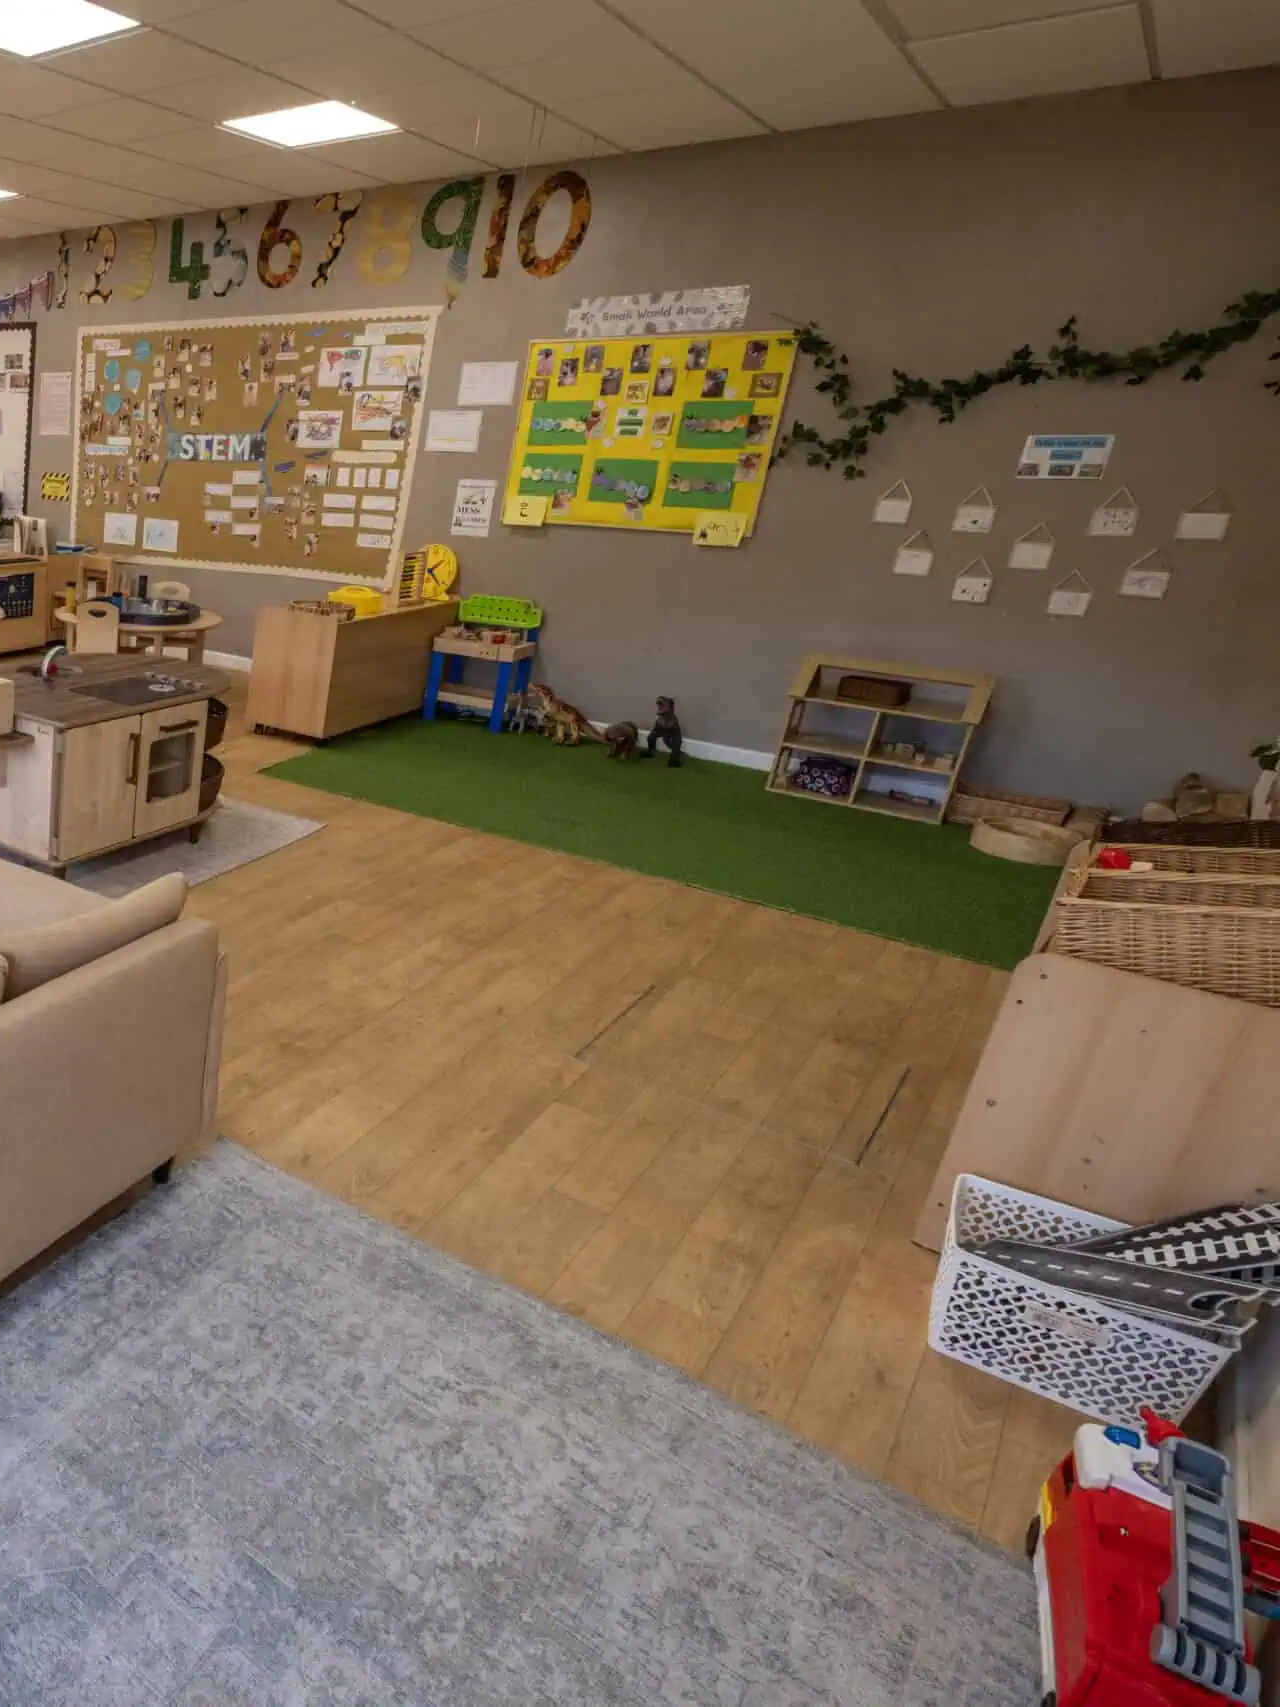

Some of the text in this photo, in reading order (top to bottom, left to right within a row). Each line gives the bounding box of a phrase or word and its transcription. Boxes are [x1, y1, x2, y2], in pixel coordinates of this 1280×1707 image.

[78, 224, 117, 304] 2
[169, 216, 210, 300] 4
[208, 207, 249, 297] 5
[256, 199, 302, 289] 6
[310, 191, 363, 289] 7
[356, 189, 417, 287] 8
[420, 176, 486, 290] 9
[481, 169, 593, 280] 10
[638, 304, 671, 320] World
[180, 433, 251, 461] STEM
